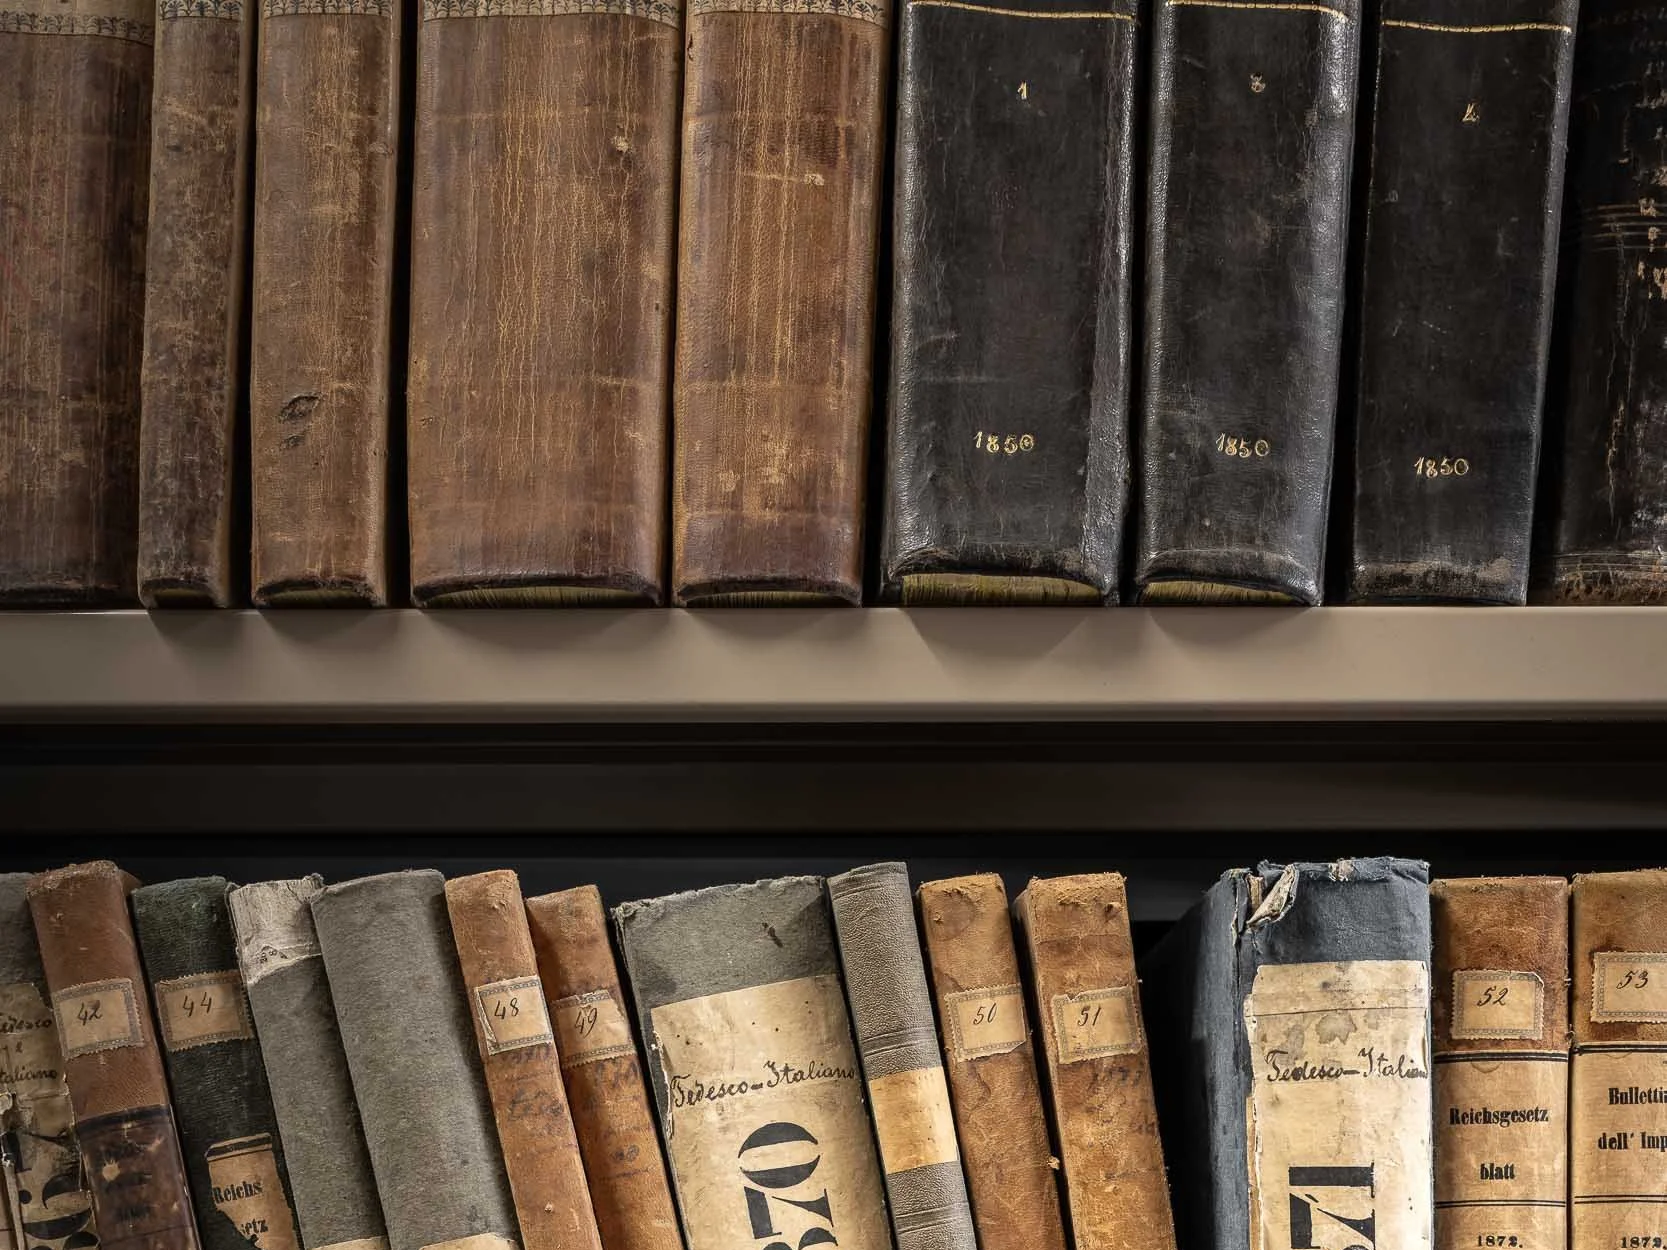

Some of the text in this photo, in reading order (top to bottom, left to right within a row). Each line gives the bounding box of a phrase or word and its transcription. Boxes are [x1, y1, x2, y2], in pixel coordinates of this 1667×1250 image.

[973, 431, 1035, 455] 1850
[1215, 432, 1271, 459] 1850
[1413, 456, 1469, 479] 1850
[1616, 968, 1649, 990] 53
[182, 991, 212, 1018] 44
[1476, 986, 1509, 1007] 52
[77, 1000, 102, 1026] 42
[494, 997, 520, 1020] 48
[972, 1002, 997, 1026] 50
[1077, 1005, 1102, 1027] 51
[0, 1013, 53, 1033] edesco
[574, 1007, 598, 1038] 49
[1450, 1106, 1549, 1128] Reichsgesetz
[1480, 1163, 1515, 1181] blatt
[213, 1180, 263, 1204] Reichs
